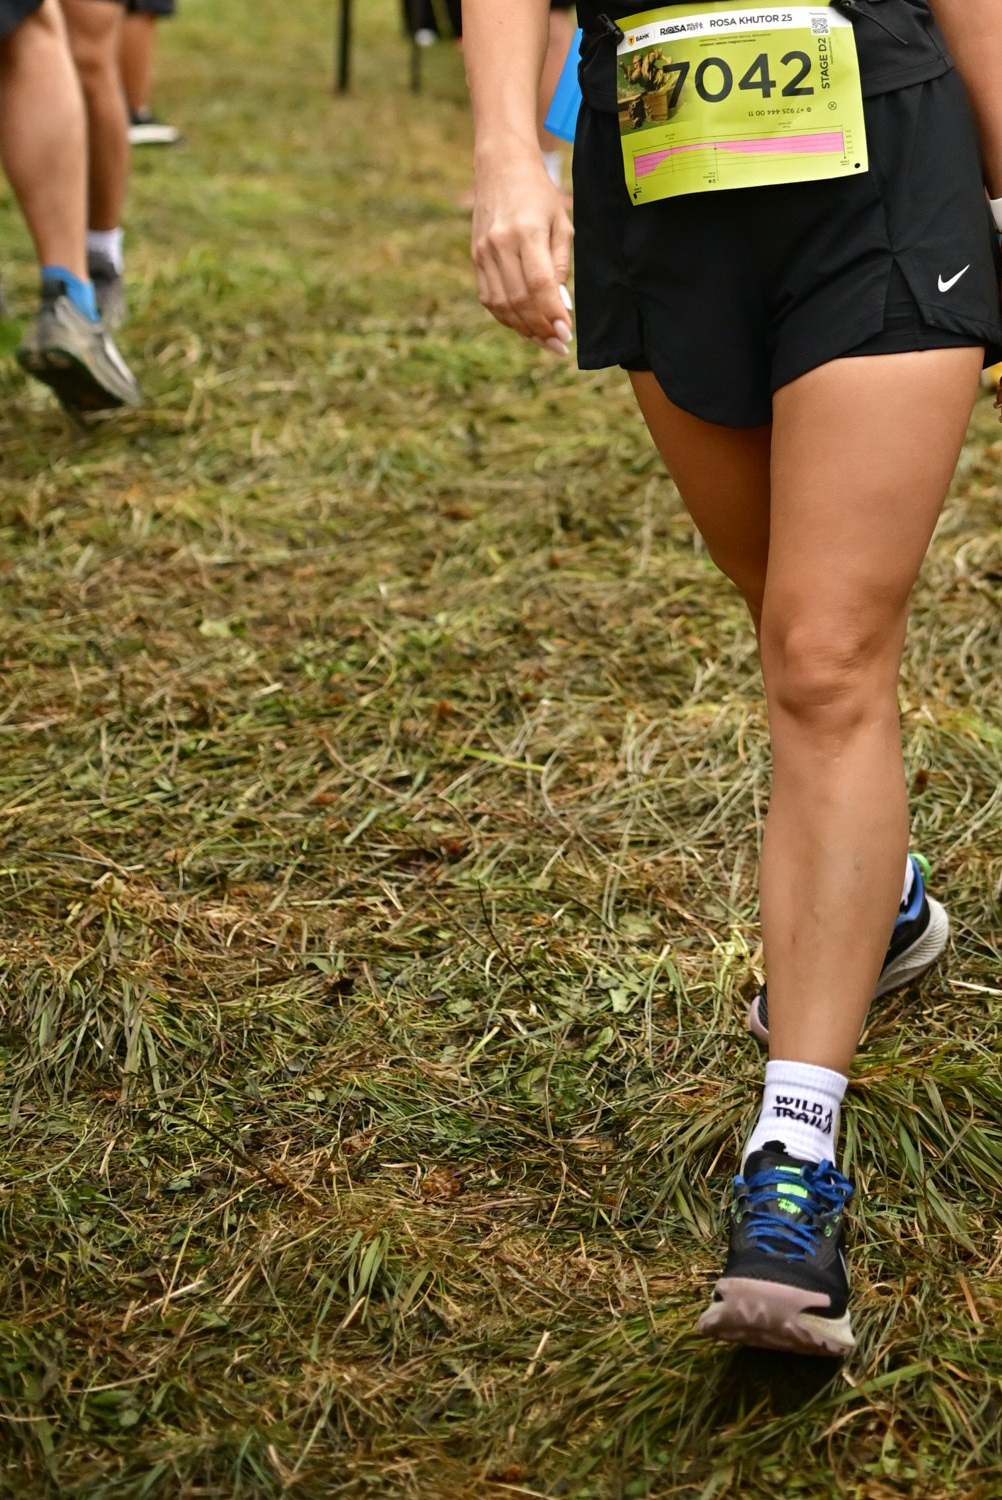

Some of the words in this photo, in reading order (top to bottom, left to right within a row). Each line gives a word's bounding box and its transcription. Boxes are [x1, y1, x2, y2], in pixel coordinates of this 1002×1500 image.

[710, 18, 737, 28] ROSA
[739, 14, 780, 25] KHUTOR
[781, 14, 793, 22] 25
[636, 33, 650, 42] БАНК
[817, 37, 827, 52] D2
[662, 50, 815, 109] 7042
[819, 54, 830, 89] STAGE
[782, 107, 795, 115] 925
[776, 1095, 823, 1116] WILD
[773, 1106, 822, 1129] TRAIL
